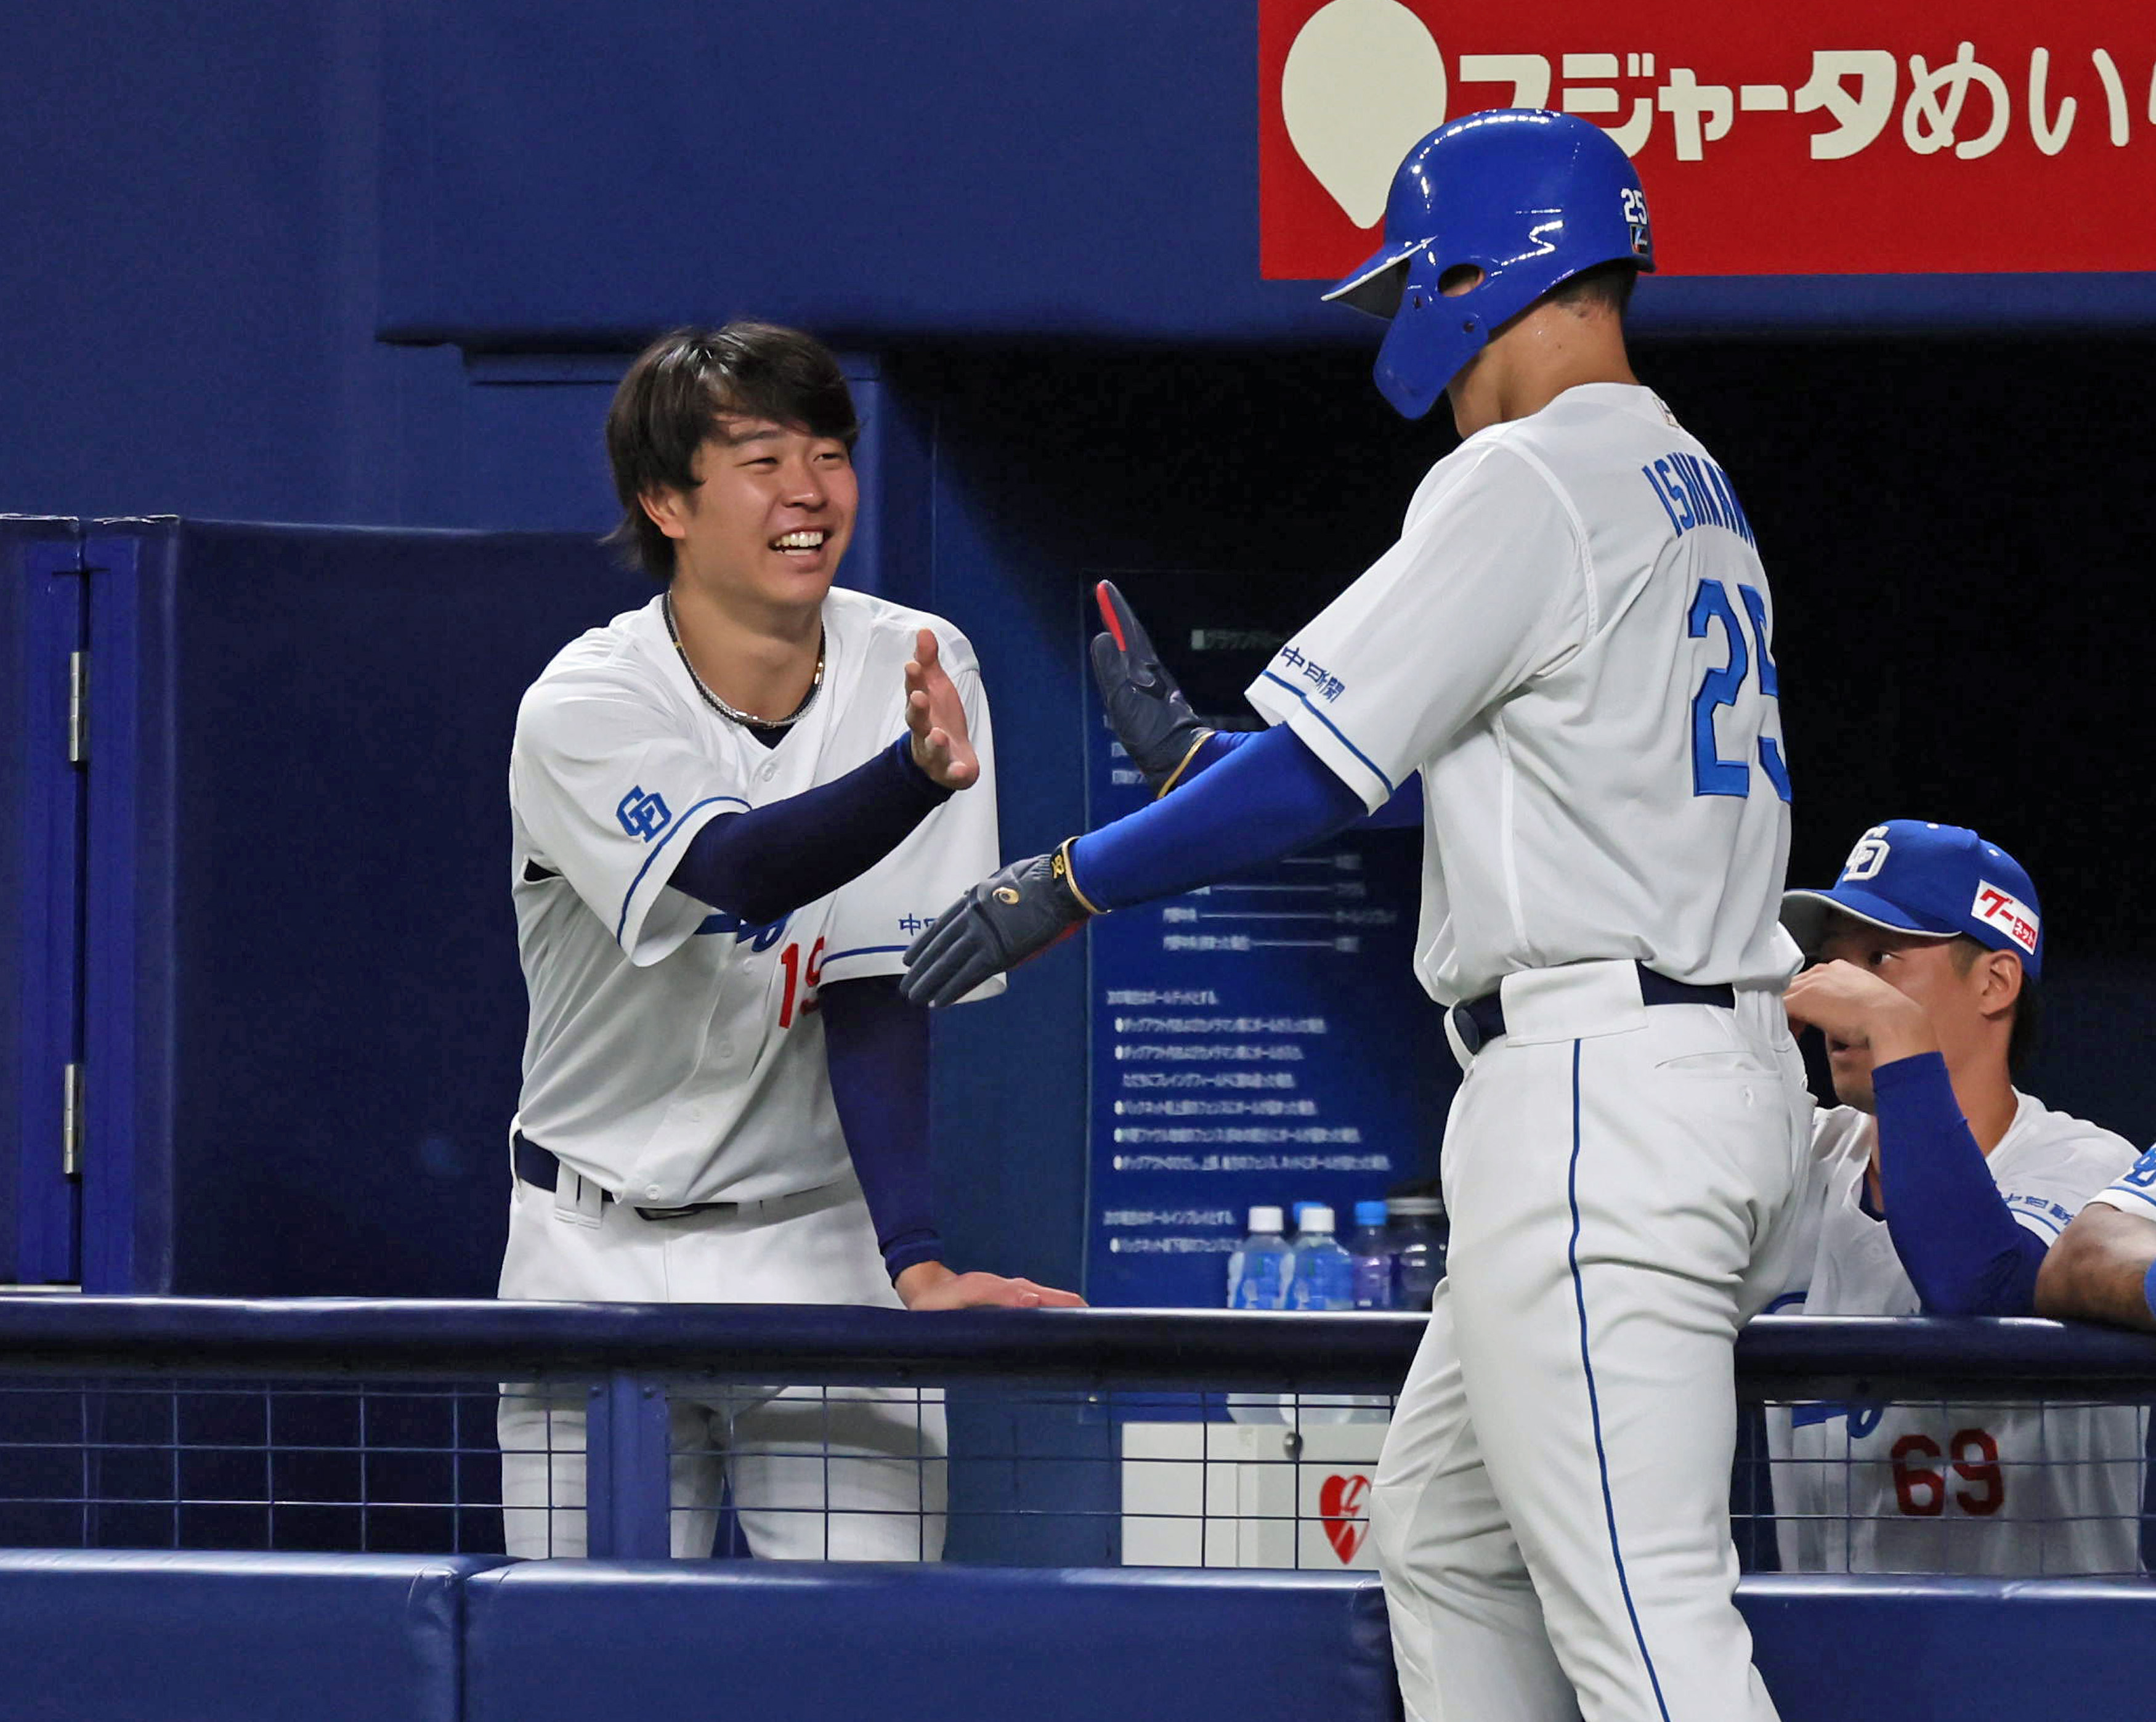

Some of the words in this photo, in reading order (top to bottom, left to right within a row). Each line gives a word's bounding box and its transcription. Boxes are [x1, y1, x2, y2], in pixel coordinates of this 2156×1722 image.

[1621, 188, 1648, 225] 25
[1688, 578, 1793, 803] 25
[1891, 1428, 2003, 1516] 69
